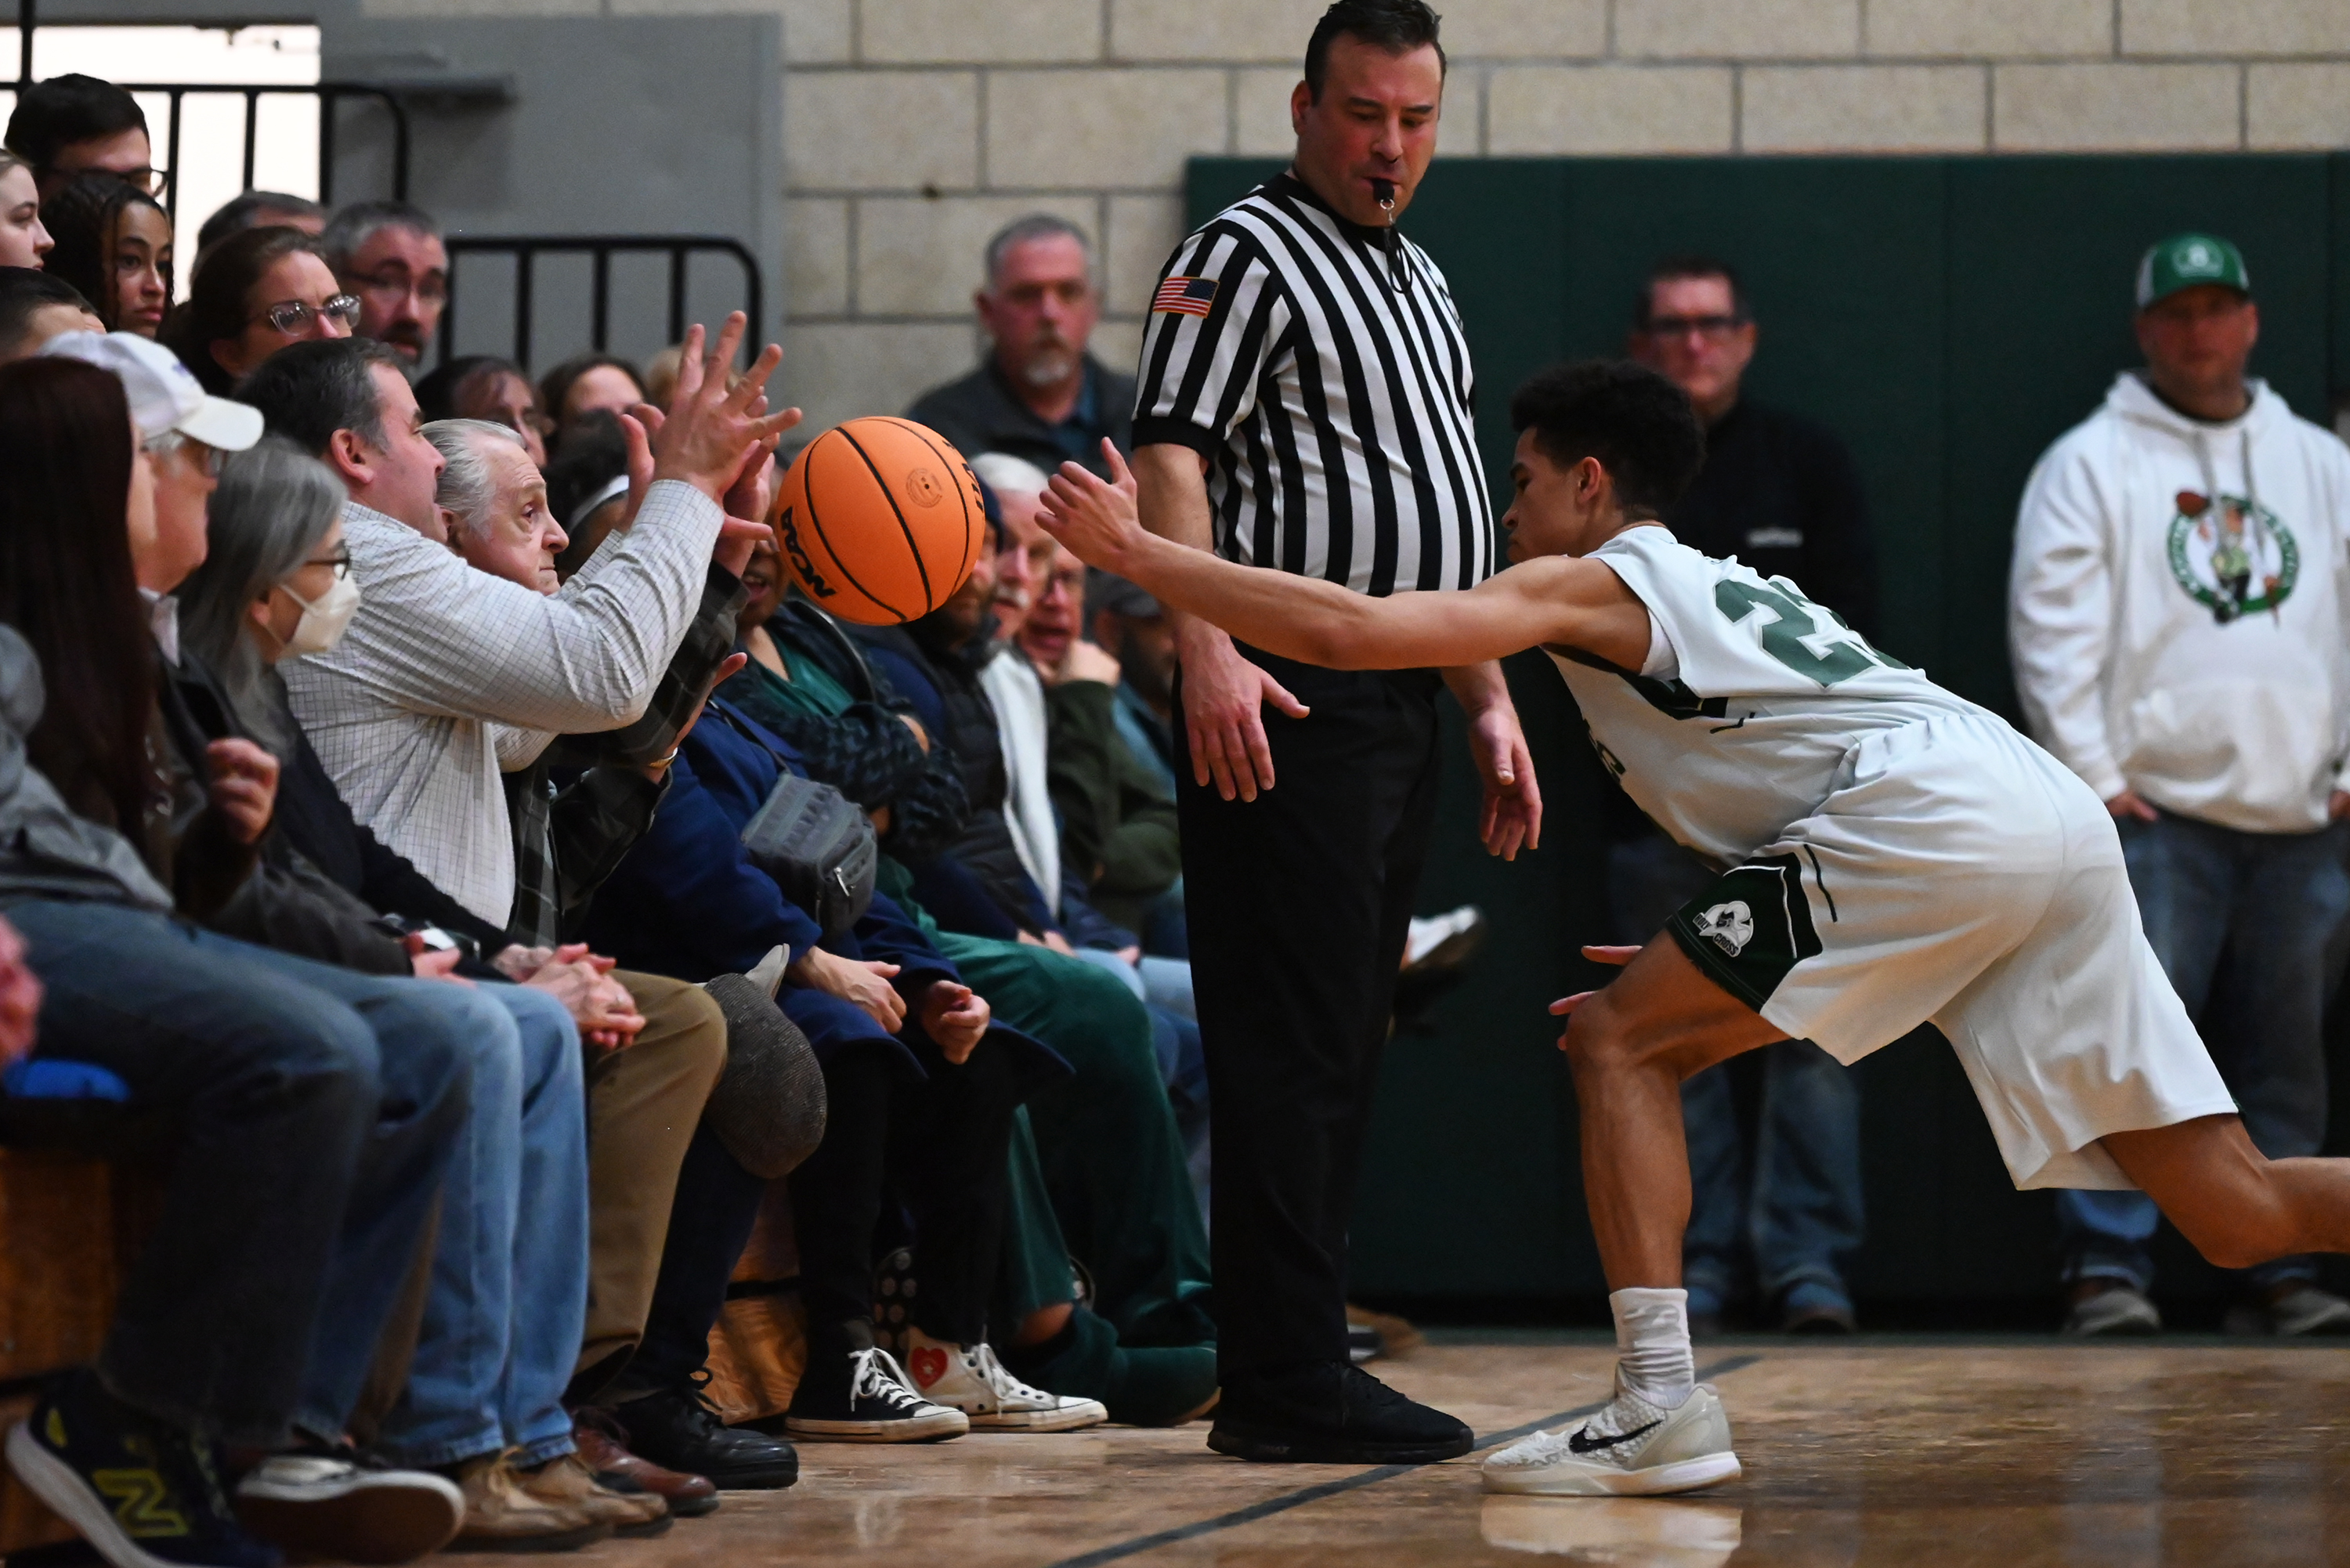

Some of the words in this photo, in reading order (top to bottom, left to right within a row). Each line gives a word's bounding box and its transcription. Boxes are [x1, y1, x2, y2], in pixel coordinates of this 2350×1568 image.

[780, 506, 837, 598] NCAA
[1693, 913, 1712, 930] HOLY
[1714, 933, 1739, 956] CROSS
